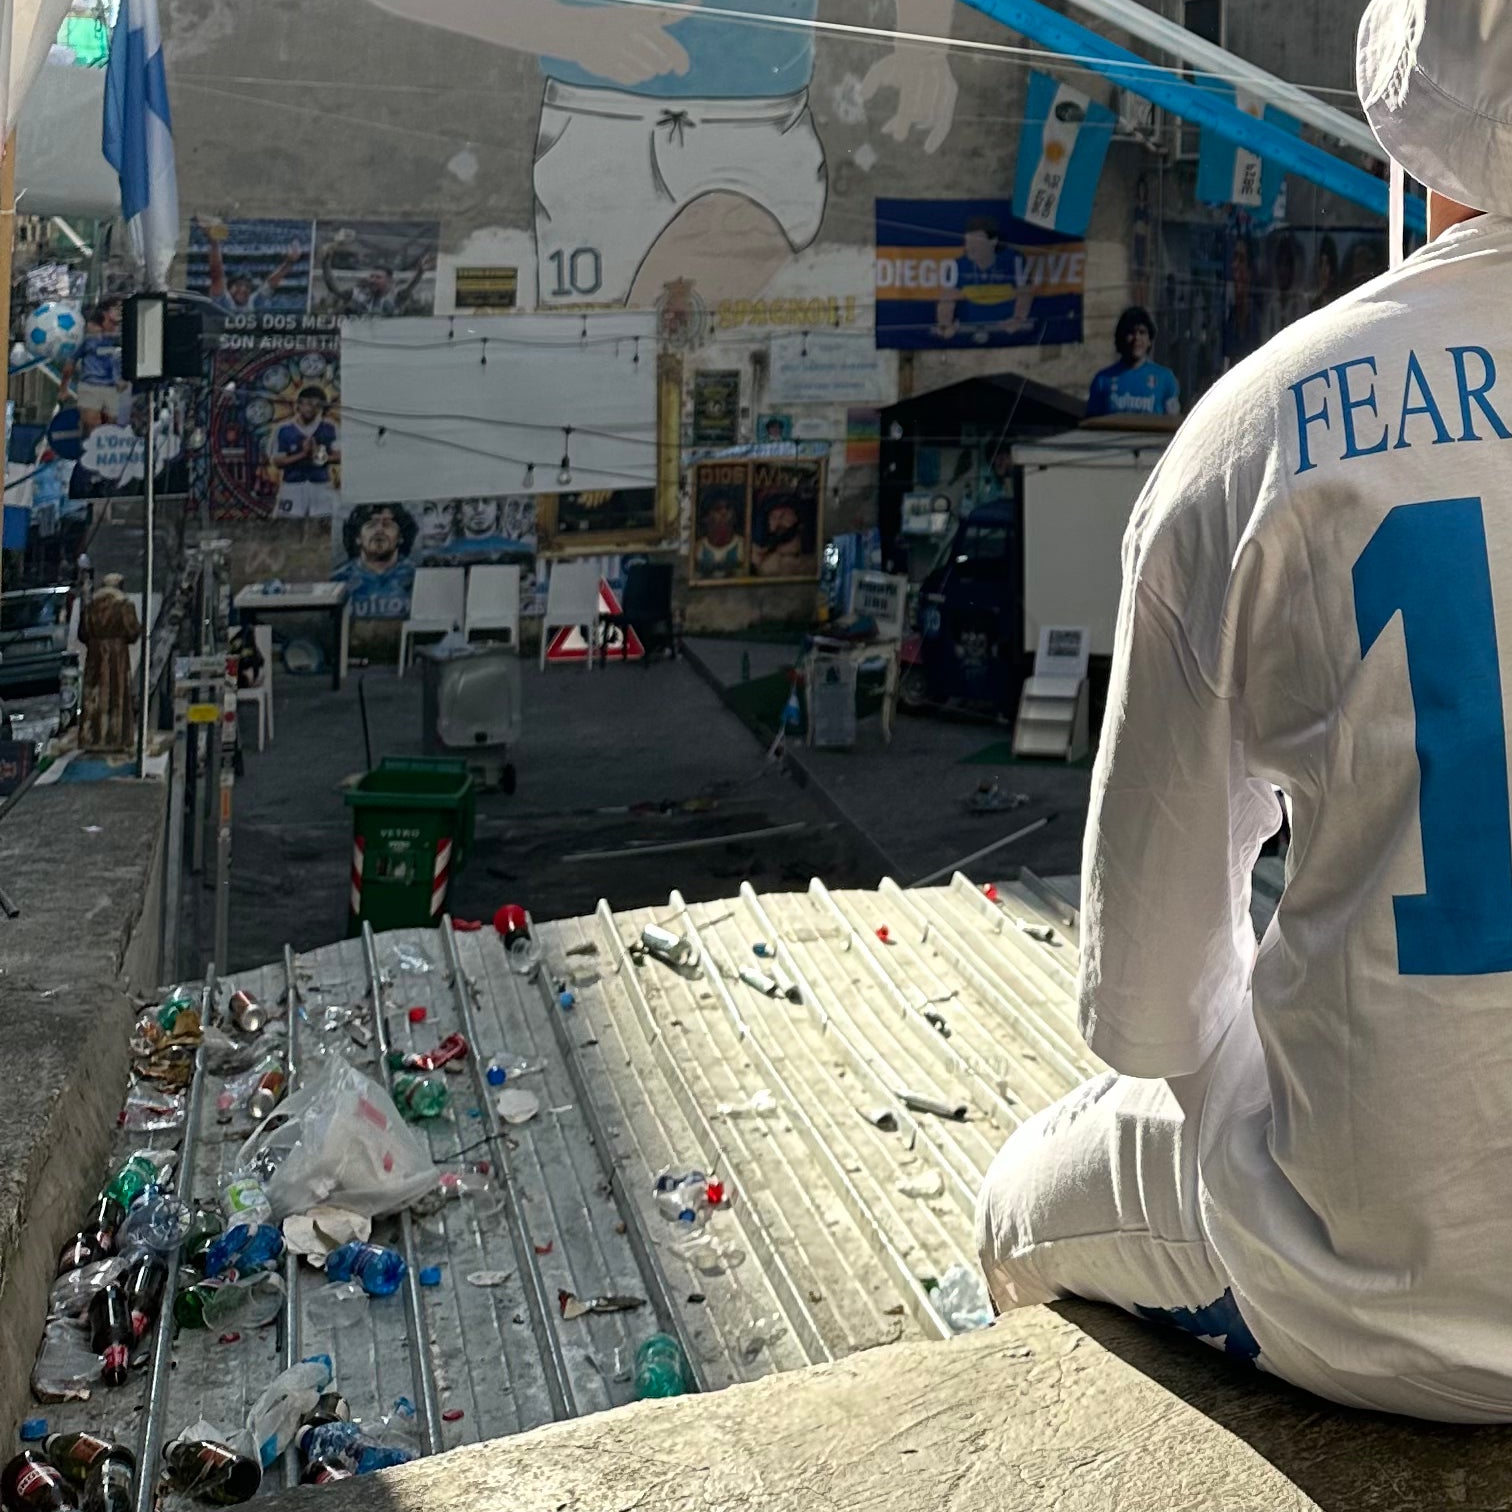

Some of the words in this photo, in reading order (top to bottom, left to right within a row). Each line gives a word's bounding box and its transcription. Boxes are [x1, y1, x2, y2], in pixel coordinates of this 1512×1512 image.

[549, 247, 602, 295] 10
[876, 256, 960, 289] DIEGO
[1013, 249, 1086, 288] VIVE
[224, 314, 257, 330] LOS
[262, 314, 297, 330] DOS
[717, 295, 856, 329] SPAGNOLI
[219, 333, 255, 350] SON
